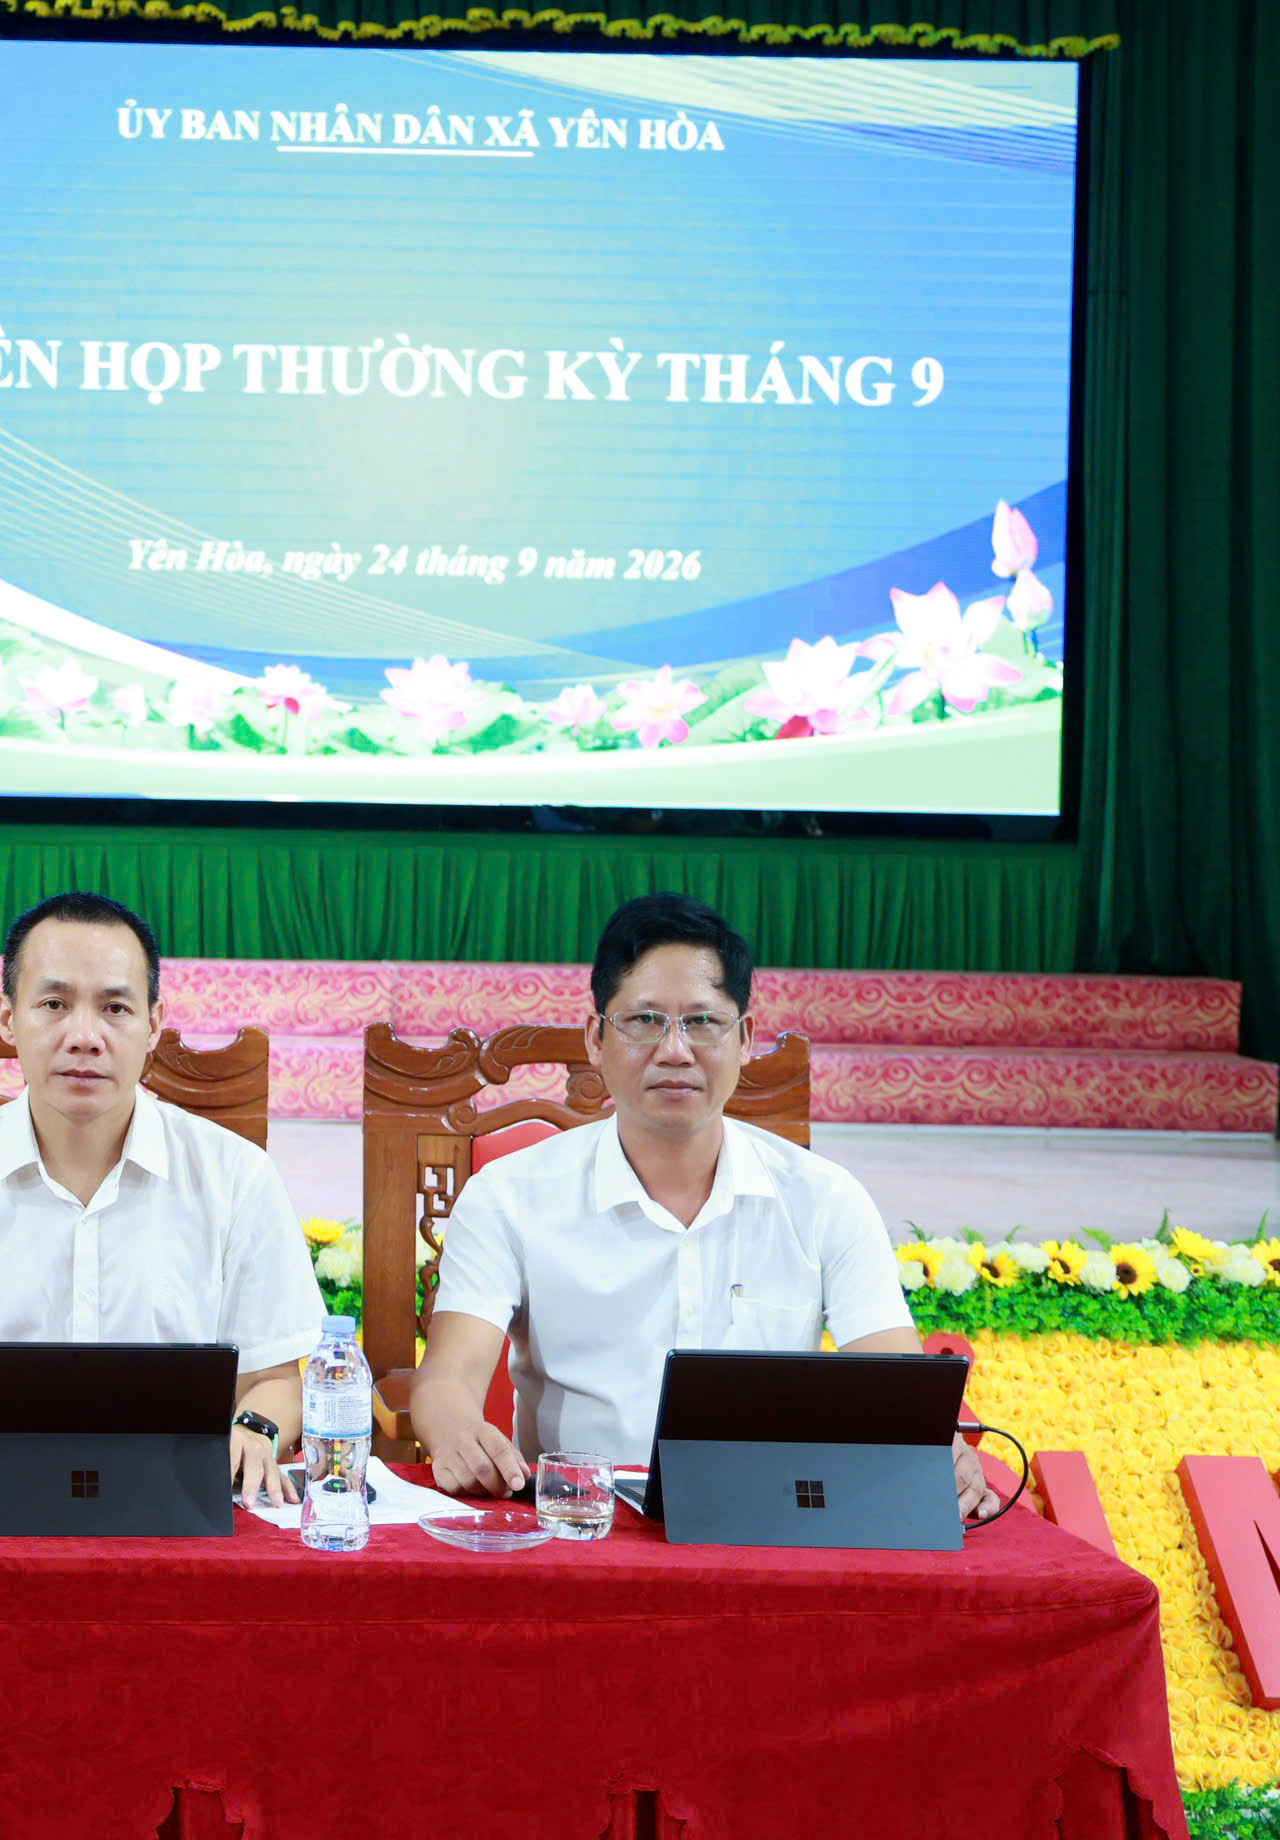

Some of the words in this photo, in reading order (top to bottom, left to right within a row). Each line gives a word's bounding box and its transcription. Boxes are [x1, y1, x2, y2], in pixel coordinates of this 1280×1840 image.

[117, 99, 171, 138] ỦY
[180, 109, 260, 140] BAN
[271, 103, 382, 143] NHÂN
[392, 105, 474, 145] DÂN
[484, 108, 540, 148] XÃ
[548, 108, 627, 149] YÊN
[639, 111, 725, 151] HÒA
[80, 341, 222, 405] HỌP
[233, 333, 529, 399] THƯỜNG
[544, 337, 642, 401] KỲ
[657, 341, 895, 406] THÁNG
[912, 357, 944, 406] 9
[128, 538, 189, 571] Yên
[194, 540, 274, 578] Hòa,
[282, 542, 362, 581] ngày
[367, 543, 409, 575] 24
[415, 545, 509, 584] tháng
[517, 547, 539, 576] 9
[543, 548, 617, 580] năm
[623, 549, 702, 580] 2026
